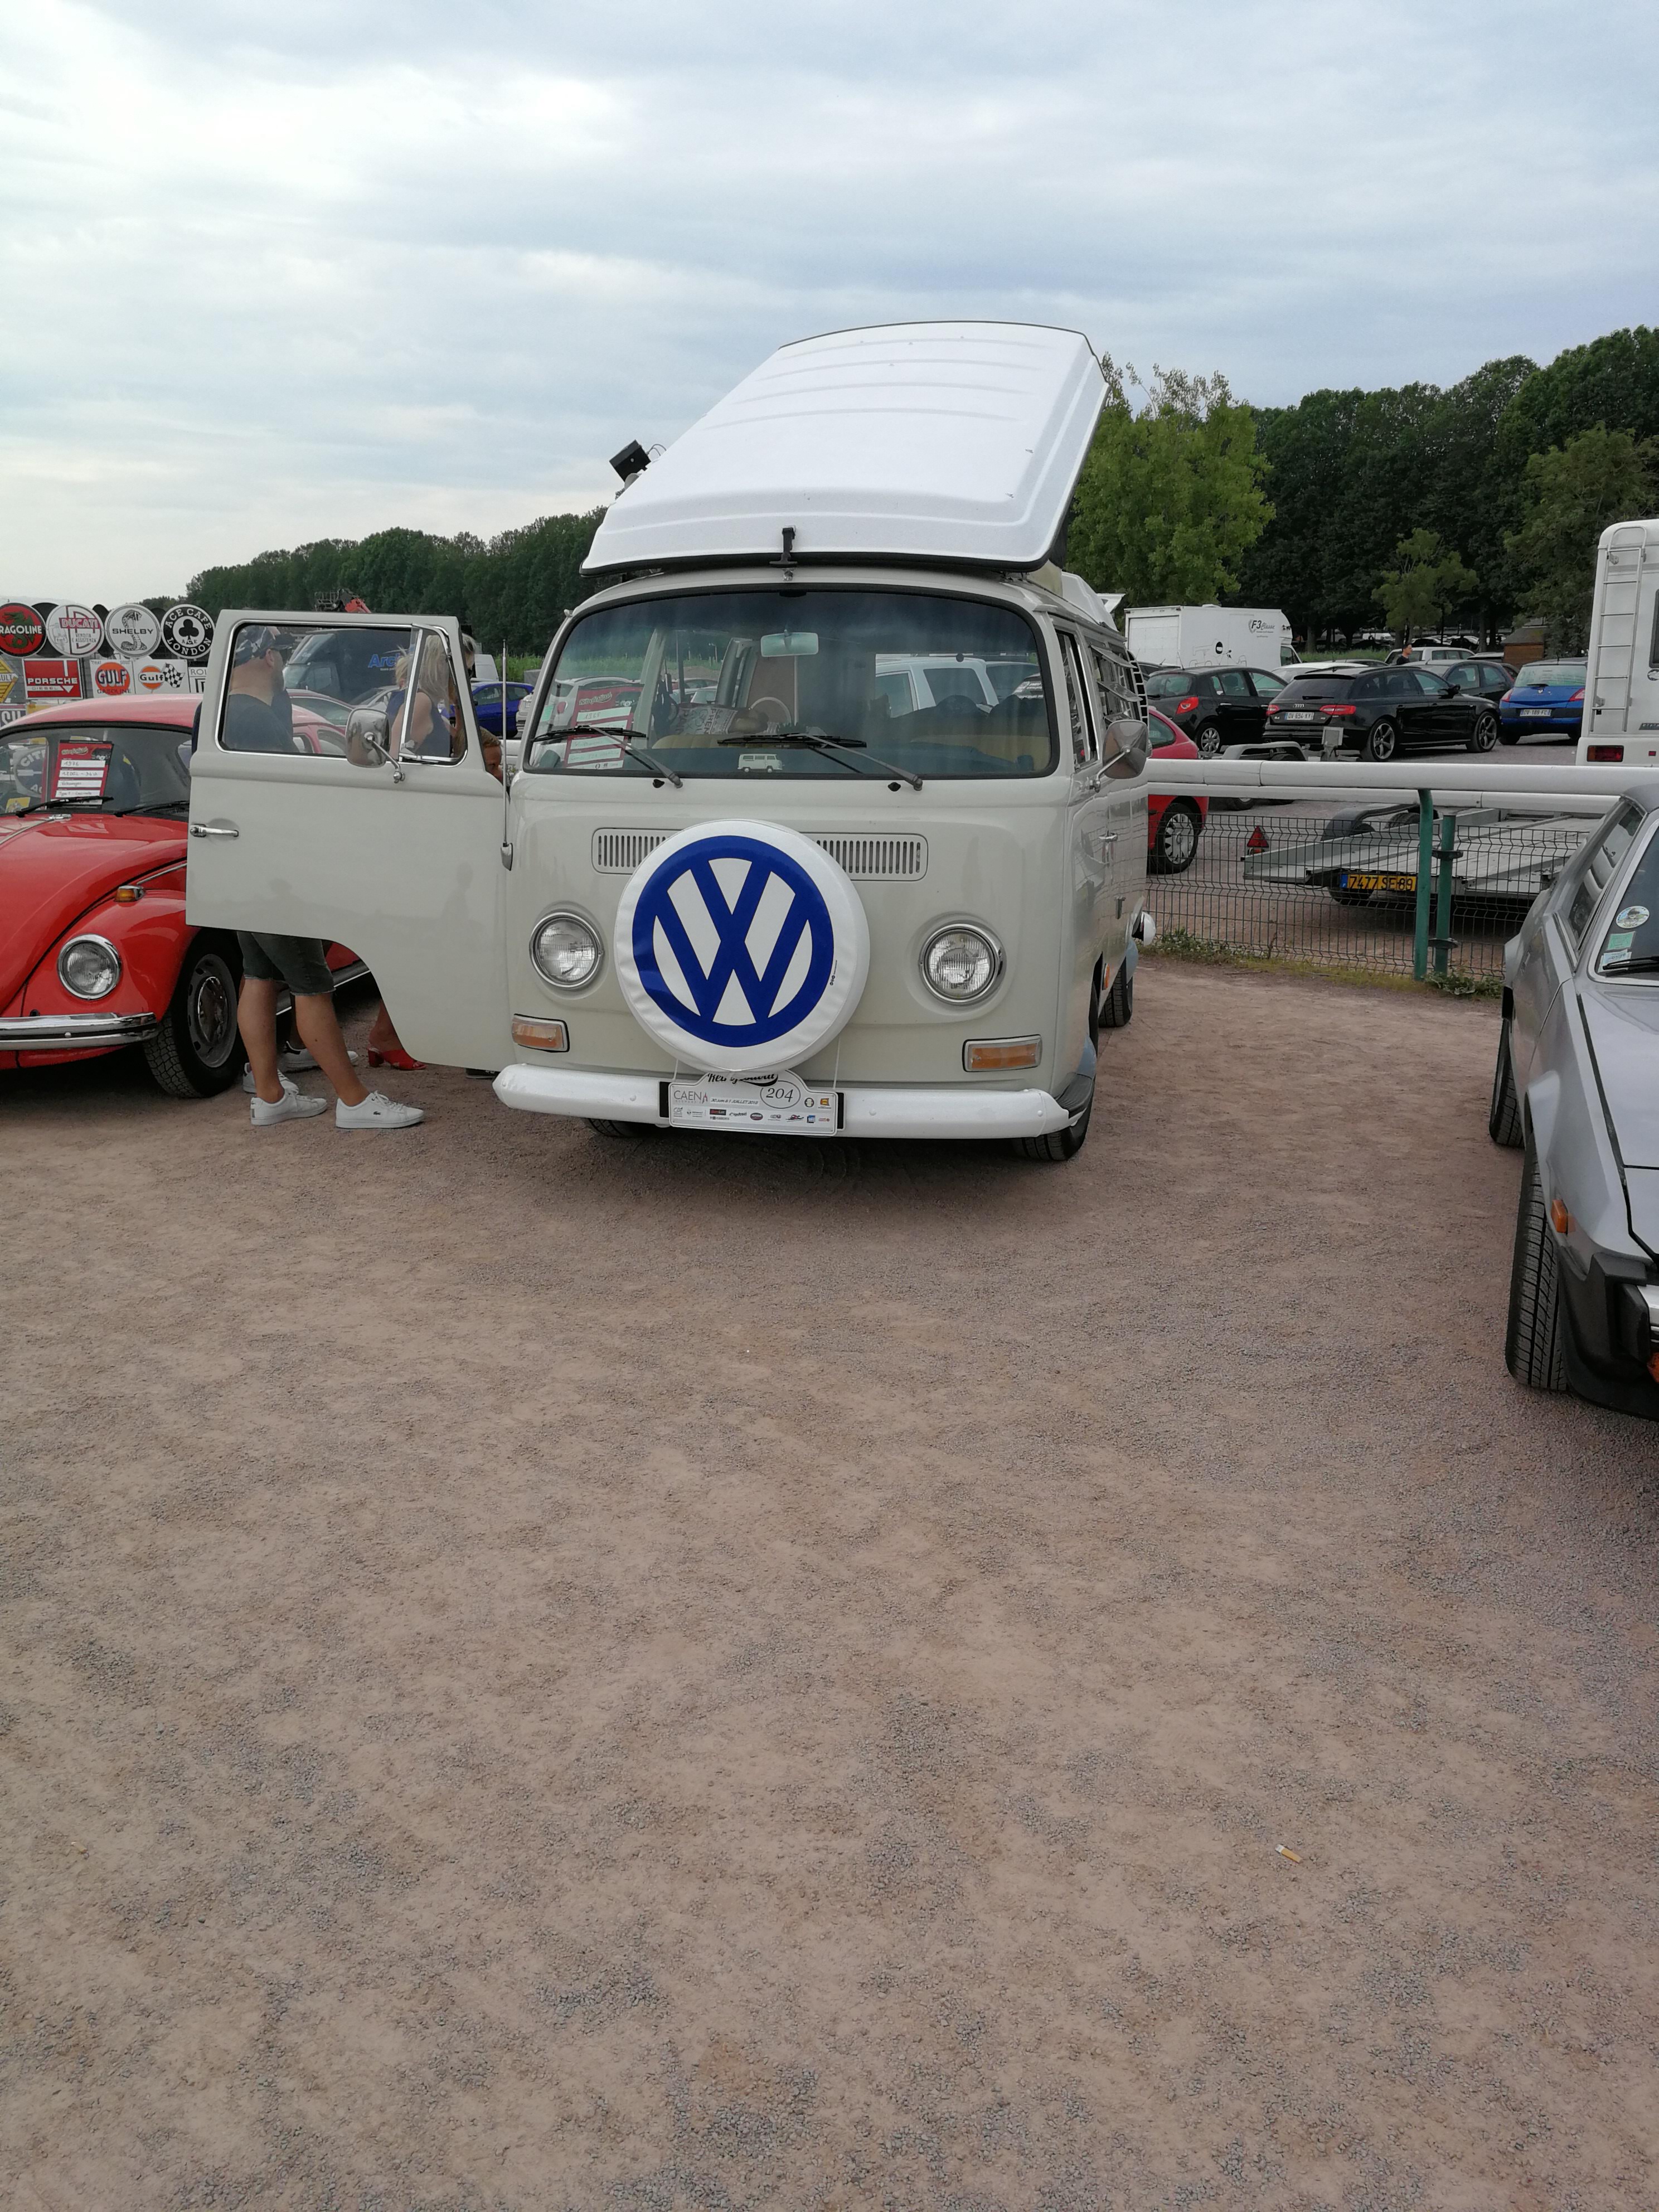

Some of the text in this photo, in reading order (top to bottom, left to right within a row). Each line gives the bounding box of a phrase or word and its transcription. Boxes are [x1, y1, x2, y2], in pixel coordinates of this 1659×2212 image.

[61, 618, 99, 628] DUCATI
[166, 608, 212, 629] ACE CAFE
[1251, 620, 1262, 629] F3
[0, 625, 42, 634] RAGOLINE
[167, 637, 212, 656] LONDON
[96, 670, 128, 687] GULF
[1350, 876, 1379, 890] 7477
[673, 1090, 702, 1100] CAEN
[766, 1088, 794, 1103] 204
